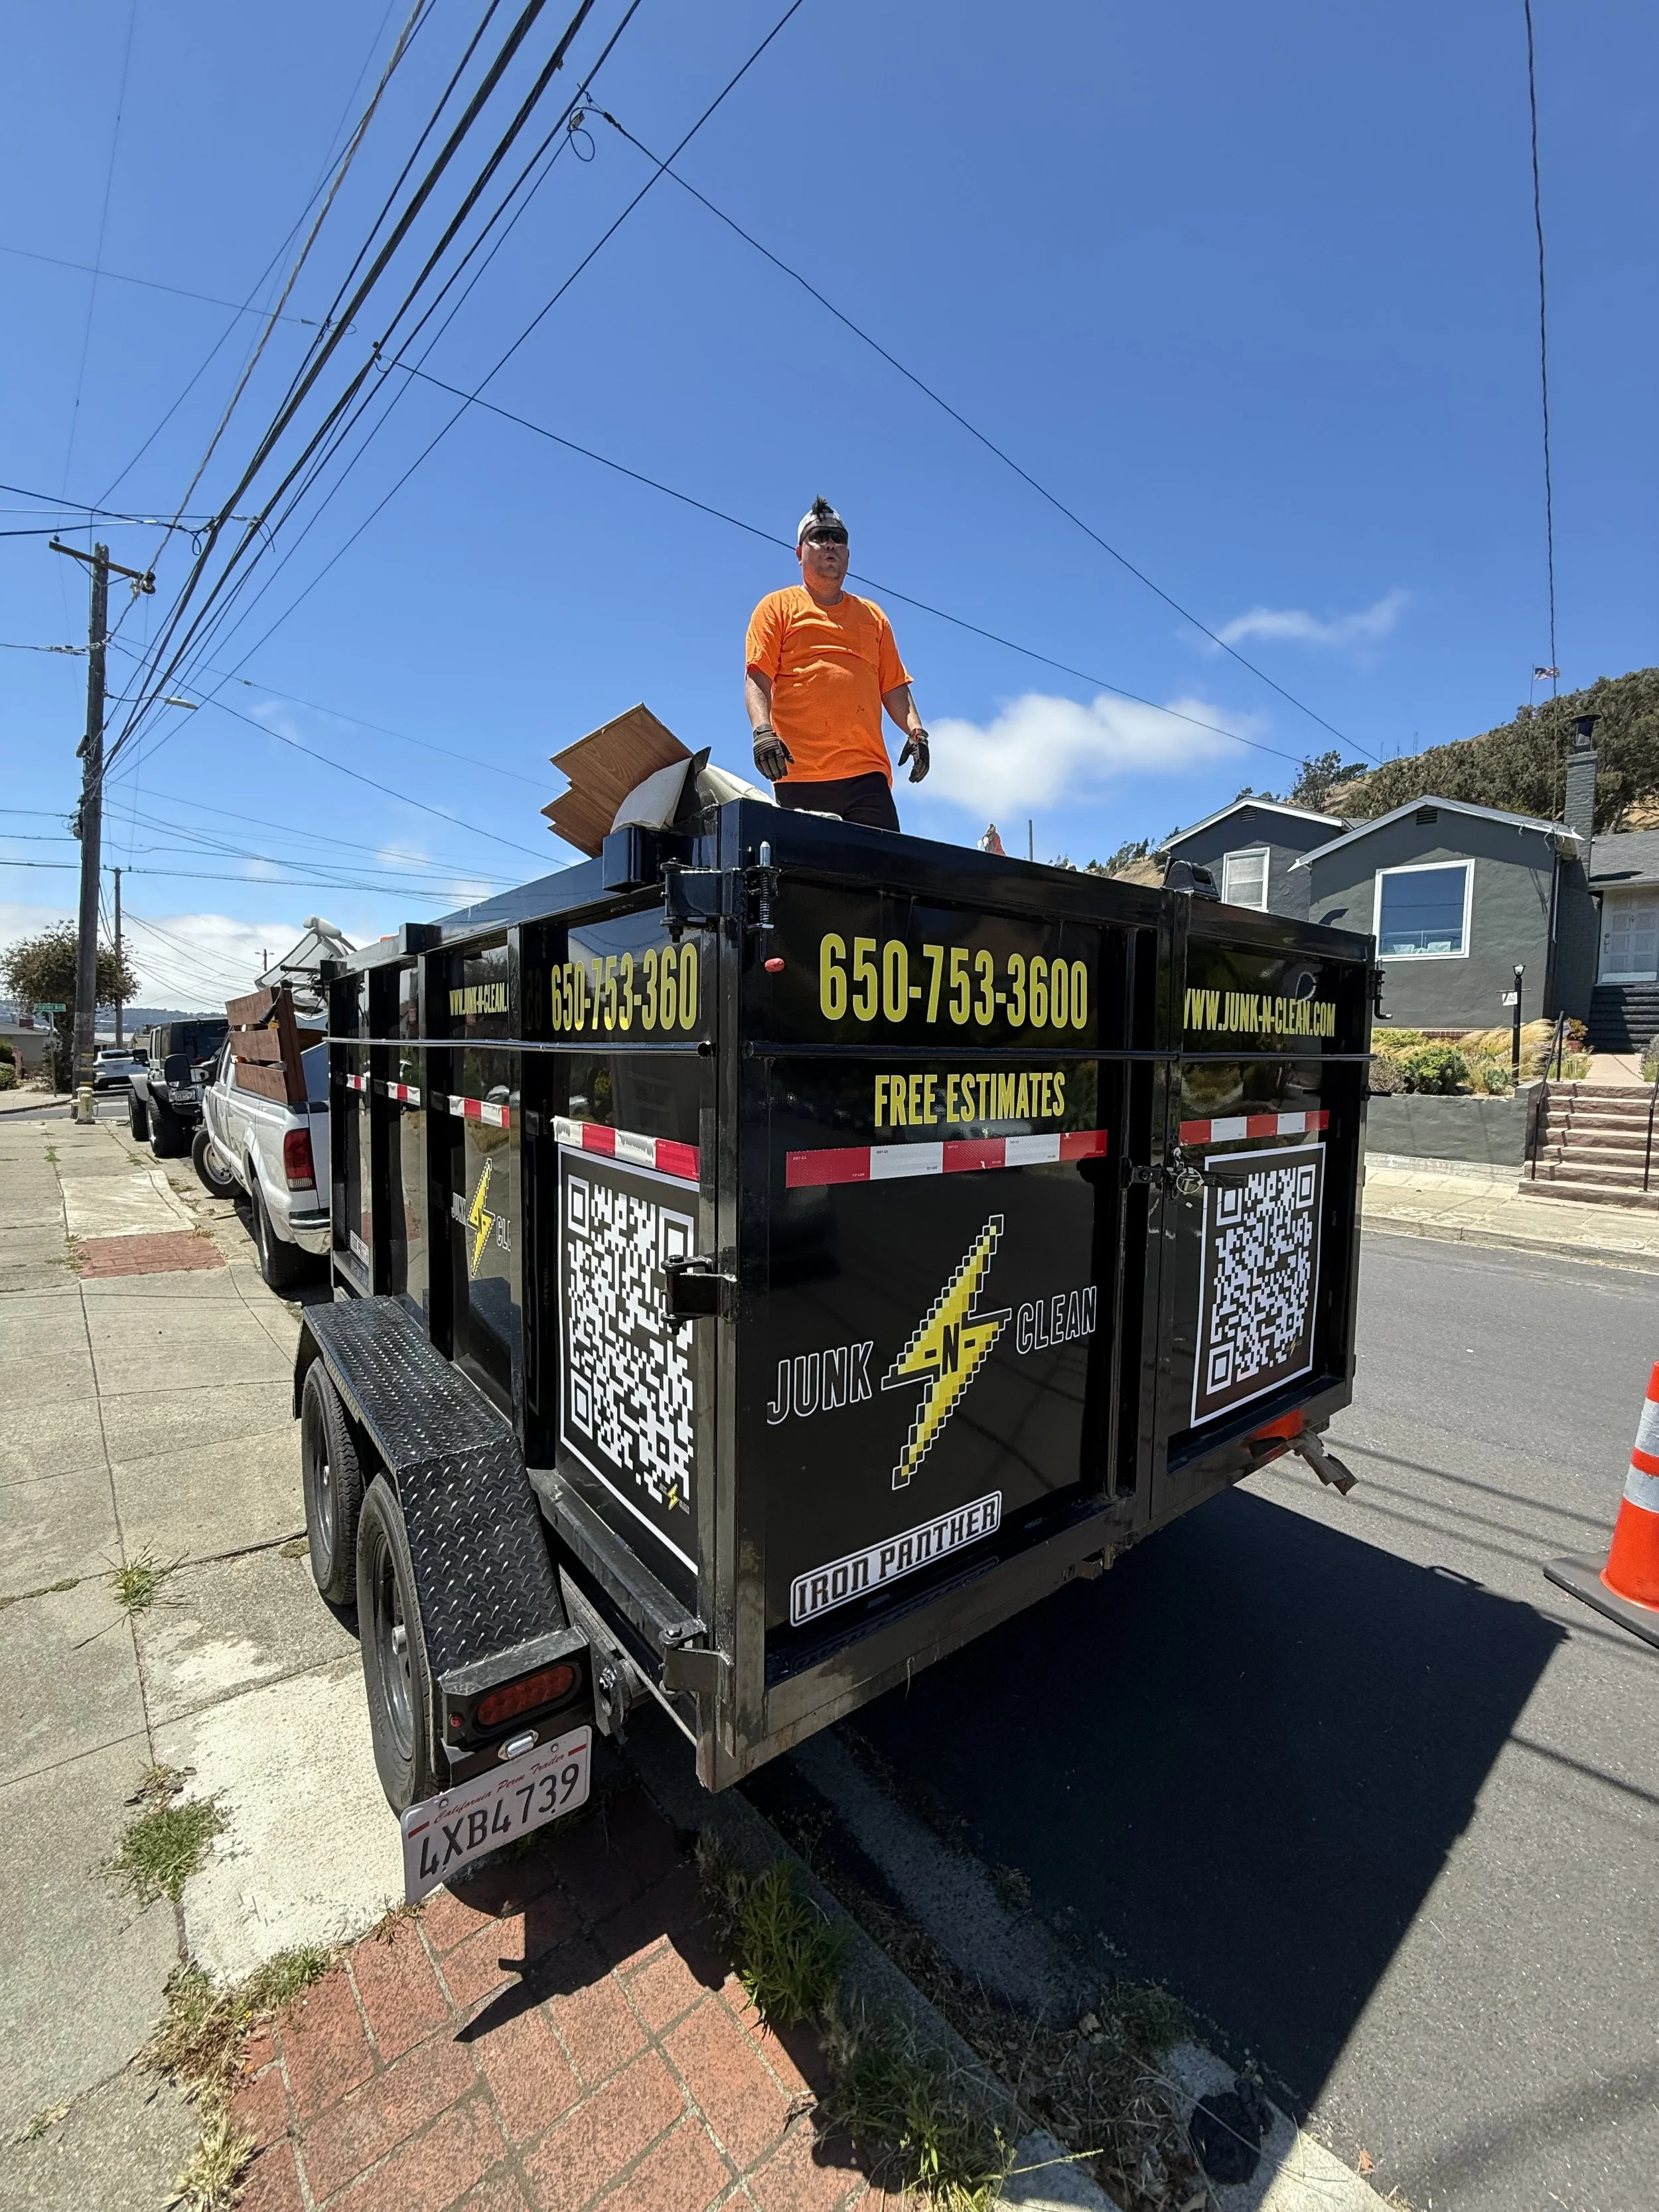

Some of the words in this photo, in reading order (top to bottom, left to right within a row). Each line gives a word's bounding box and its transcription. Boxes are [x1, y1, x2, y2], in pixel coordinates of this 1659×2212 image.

[449, 982, 510, 1016] WWW.JUNK-N-CLEAN.
[551, 942, 701, 1031] 650-753-360
[820, 932, 1088, 1029] 650-753-3600
[875, 1074, 938, 1128] FREE
[946, 1071, 1066, 1123] ESTIMATES
[451, 1192, 467, 1226] JUNK
[766, 1341, 874, 1425] JUNK
[1015, 1286, 1097, 1355] CLEAN
[798, 1556, 869, 1617] IRON
[879, 1500, 995, 1580] PANTHER
[419, 1763, 579, 1880] 4XB4739
[433, 1791, 492, 1824] California
[496, 1774, 525, 1793] Perm
[530, 1753, 565, 1775] Trailer
